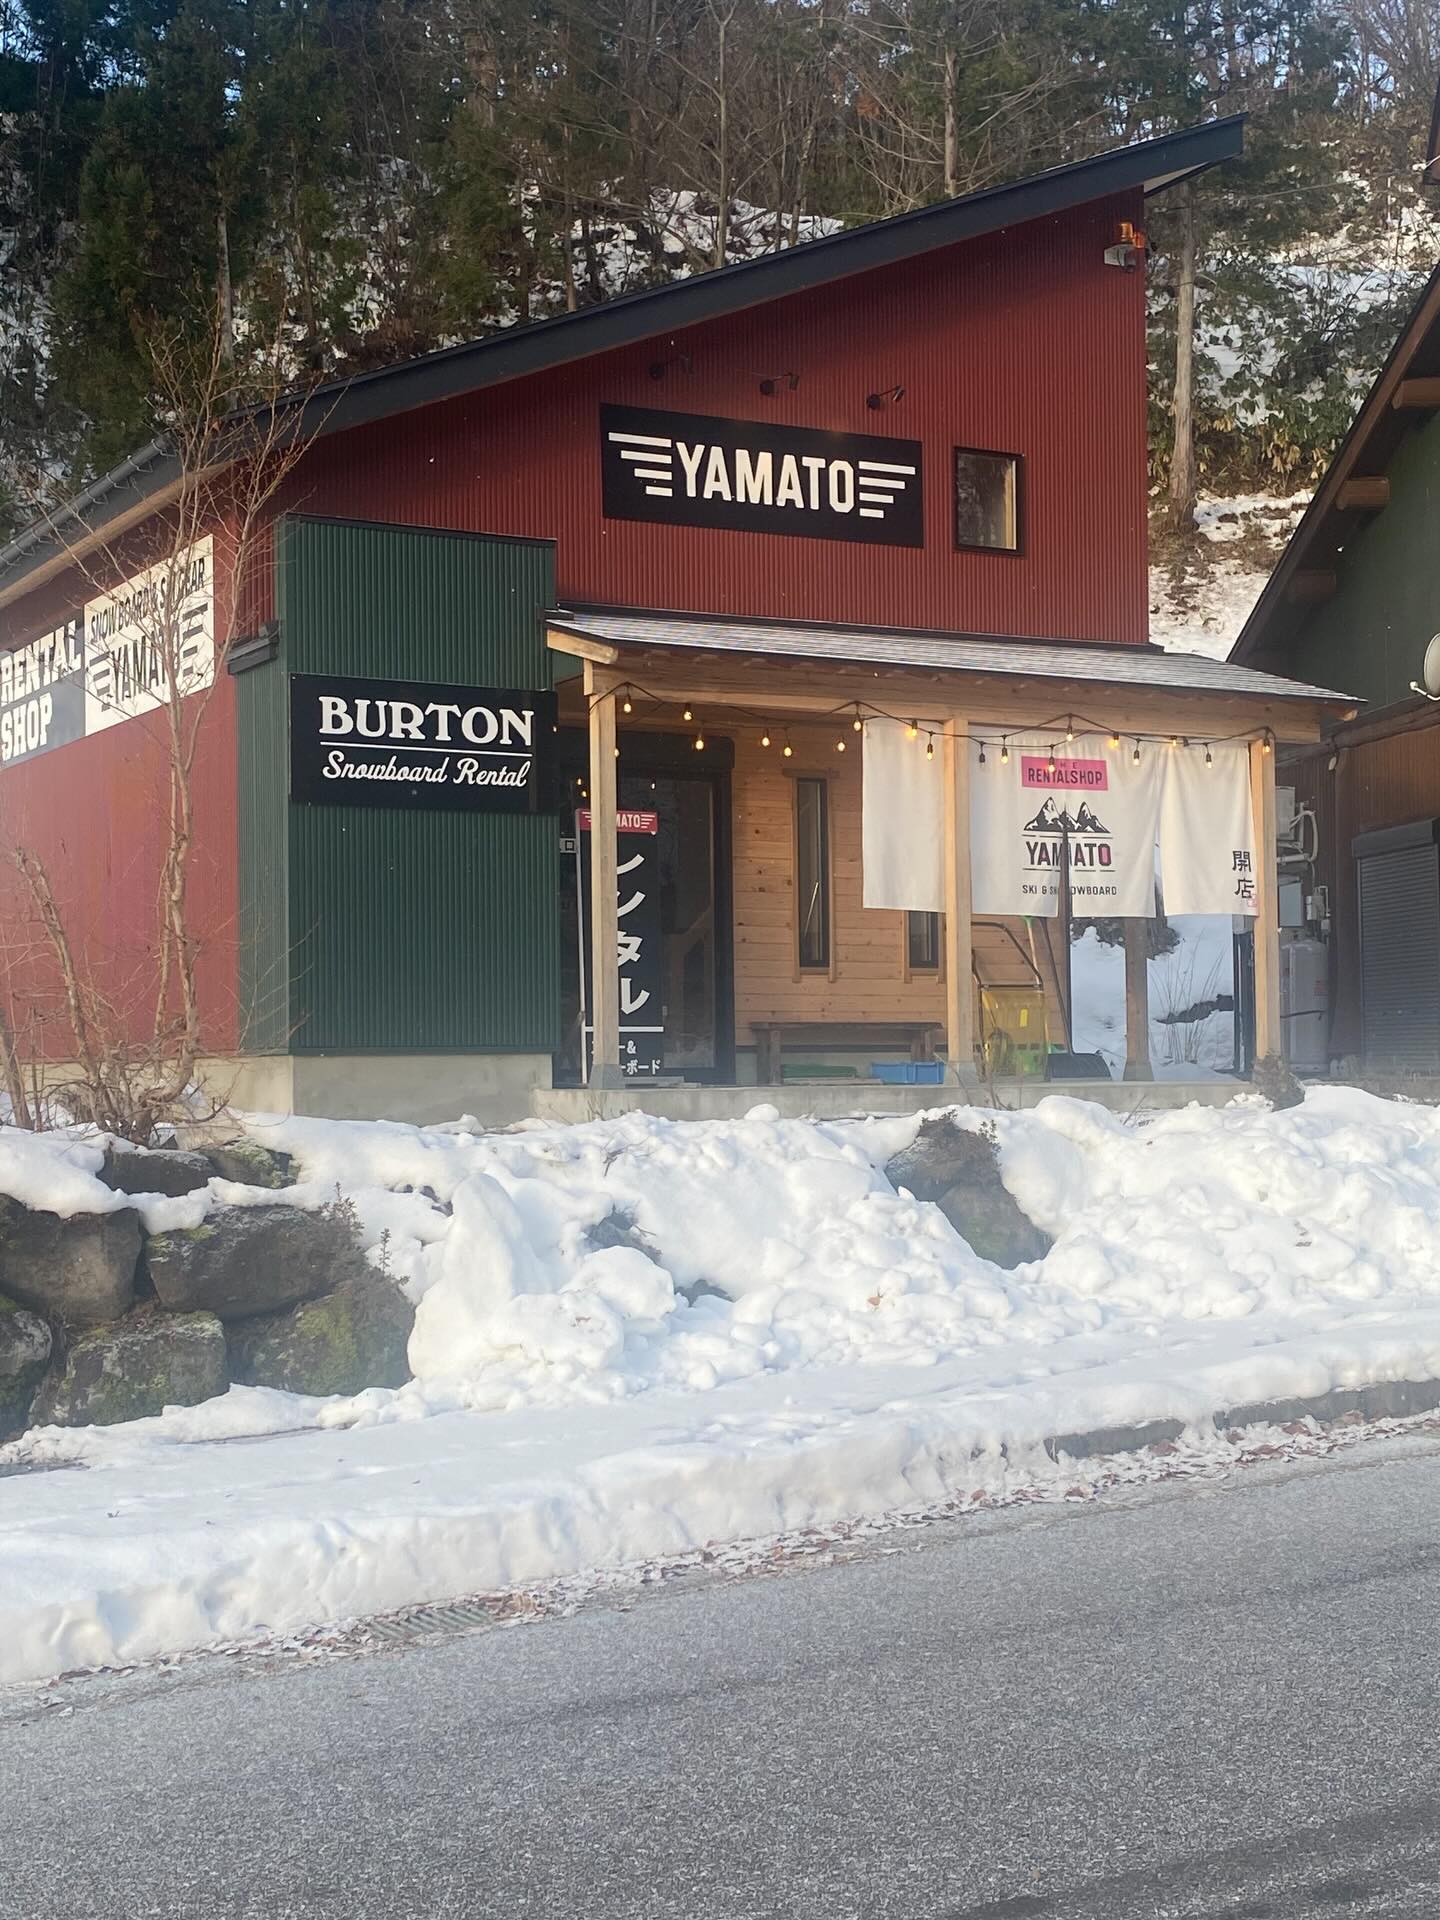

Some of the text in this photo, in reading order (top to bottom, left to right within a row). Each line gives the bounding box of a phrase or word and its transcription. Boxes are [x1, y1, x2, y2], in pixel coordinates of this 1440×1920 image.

[676, 442, 854, 513] YAMATO
[0, 620, 81, 707] RENTAL
[1, 692, 52, 761] SHOP
[319, 696, 534, 746] BURTON
[322, 750, 531, 787] Snowboard Rental
[1028, 768, 1102, 784] RENTALSHOP
[616, 813, 640, 828] ATO
[1022, 885, 1037, 894] SKI
[1041, 886, 1047, 894] &
[1232, 850, 1255, 899] 開店
